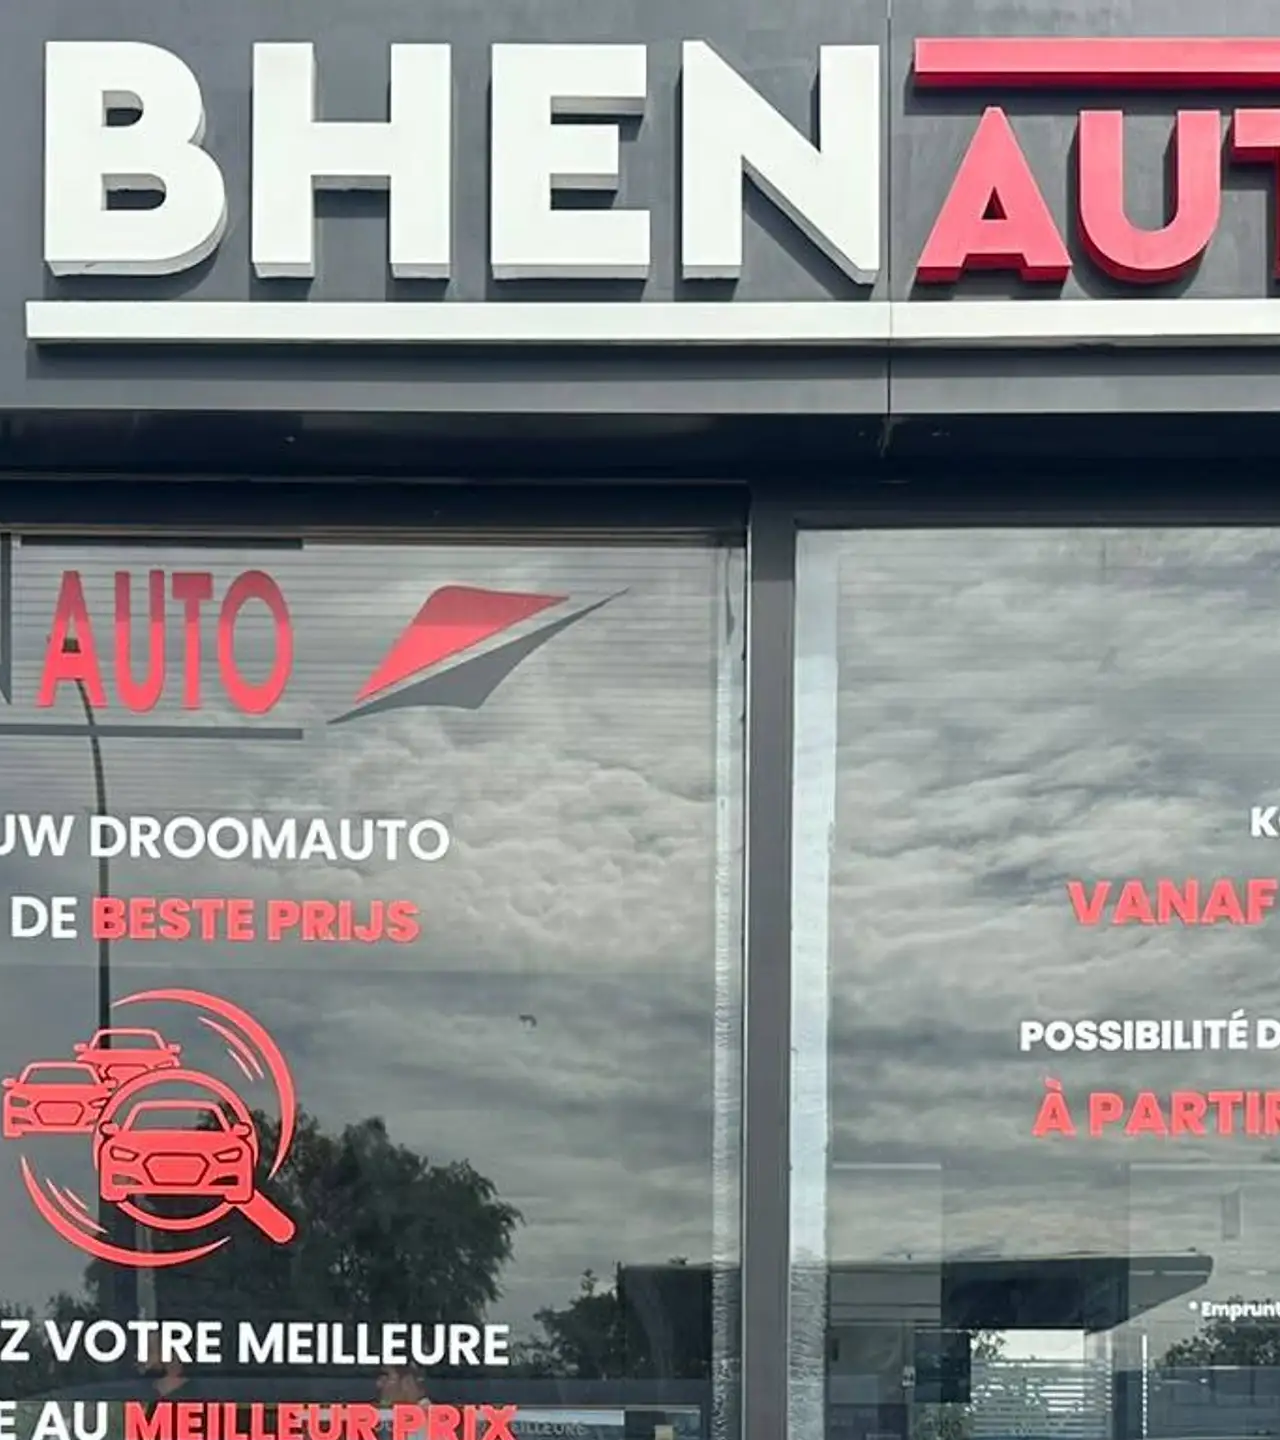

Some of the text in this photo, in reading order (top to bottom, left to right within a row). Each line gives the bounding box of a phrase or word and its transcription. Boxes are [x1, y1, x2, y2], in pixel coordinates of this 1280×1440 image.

[44, 40, 881, 285] BHEN
[36, 569, 294, 715] AUTO
[90, 815, 451, 862] DROOMAUTO
[11, 895, 78, 939] DE
[91, 896, 256, 942] BESTE
[266, 899, 421, 944] PRIJS
[1068, 878, 1278, 926] VANAF
[1020, 1008, 1249, 1052] POSSIBILITÉ
[1031, 1078, 1076, 1137] À
[44, 1319, 222, 1363] VOTRE
[237, 1322, 510, 1366] MEILLEURE
